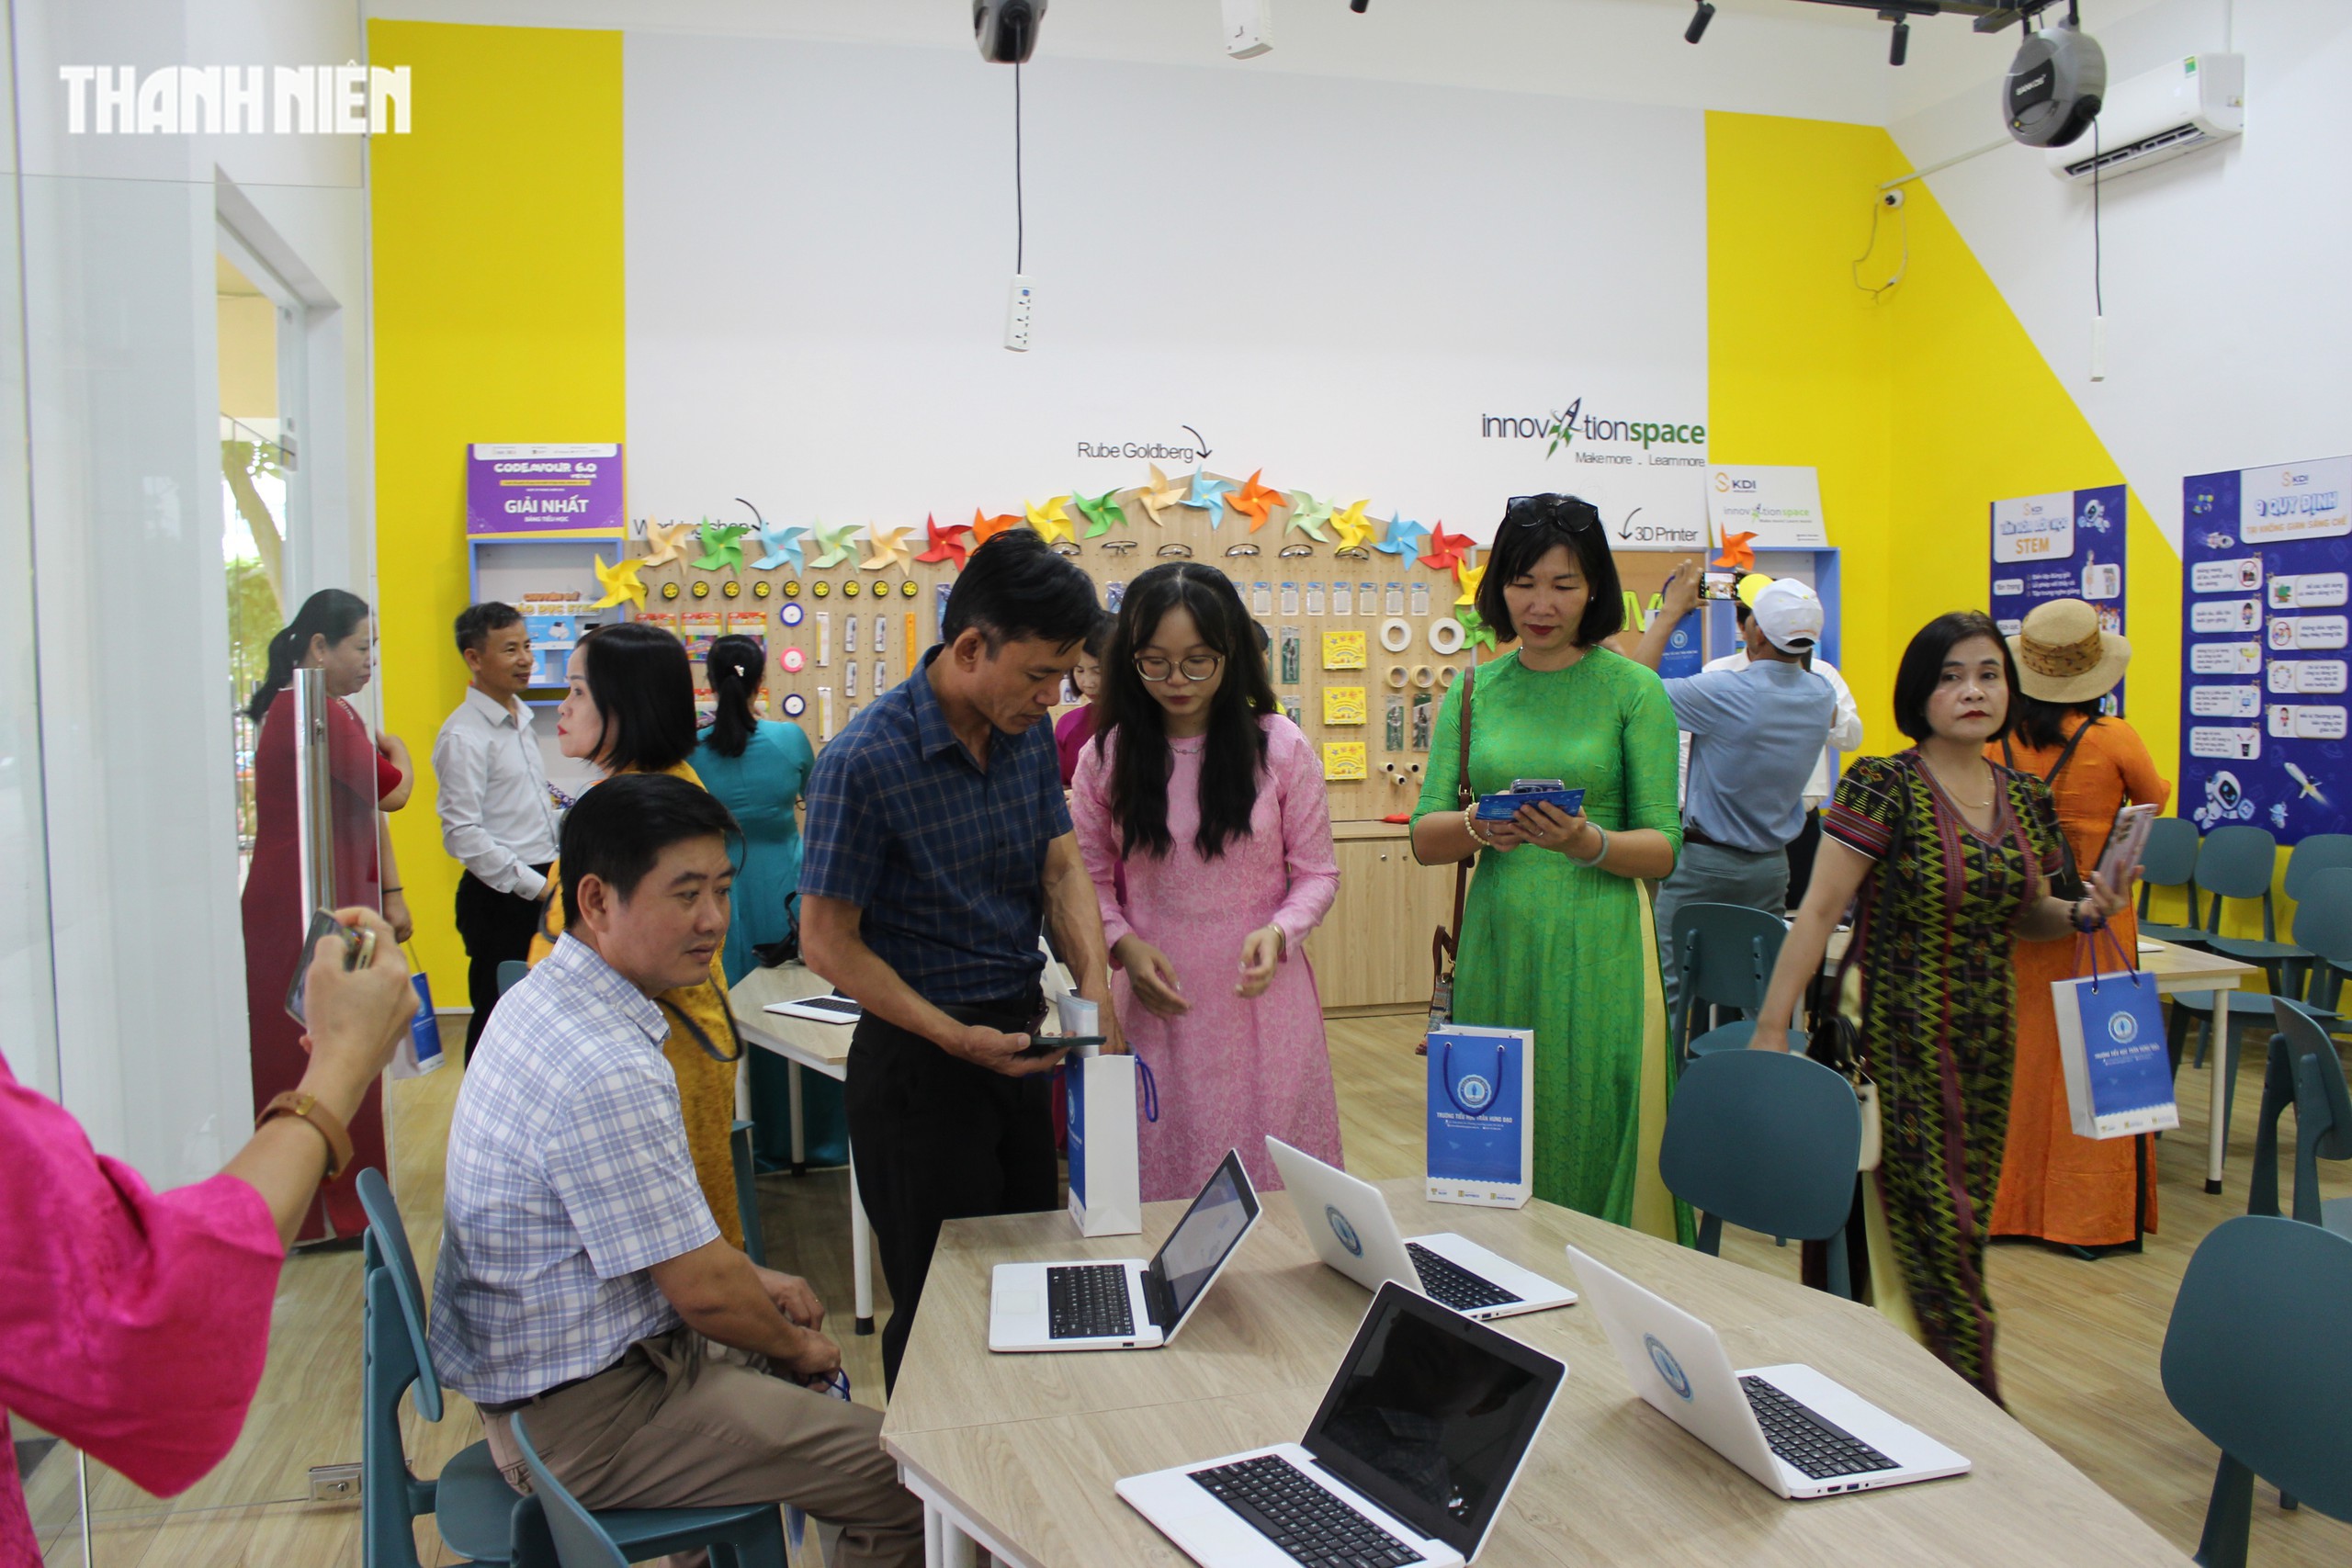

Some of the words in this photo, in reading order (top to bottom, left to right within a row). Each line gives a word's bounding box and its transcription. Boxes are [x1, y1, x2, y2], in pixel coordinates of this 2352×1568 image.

[1077, 442, 1120, 458] Rube
[1123, 442, 1193, 464] Goldberg
[1575, 452, 1604, 464] Make
[1605, 455, 1633, 465] more
[493, 462, 571, 473] CODEAVOUR
[574, 462, 597, 473] 6.0
[1732, 479, 1757, 490] KDI
[504, 495, 538, 513] GIẢI
[540, 494, 590, 513] NHẤT
[2256, 499, 2267, 517] 9
[2269, 496, 2298, 516] QUY
[1634, 526, 1654, 541] 3D
[1656, 526, 1699, 542] Printer
[2016, 536, 2050, 555] STEM
